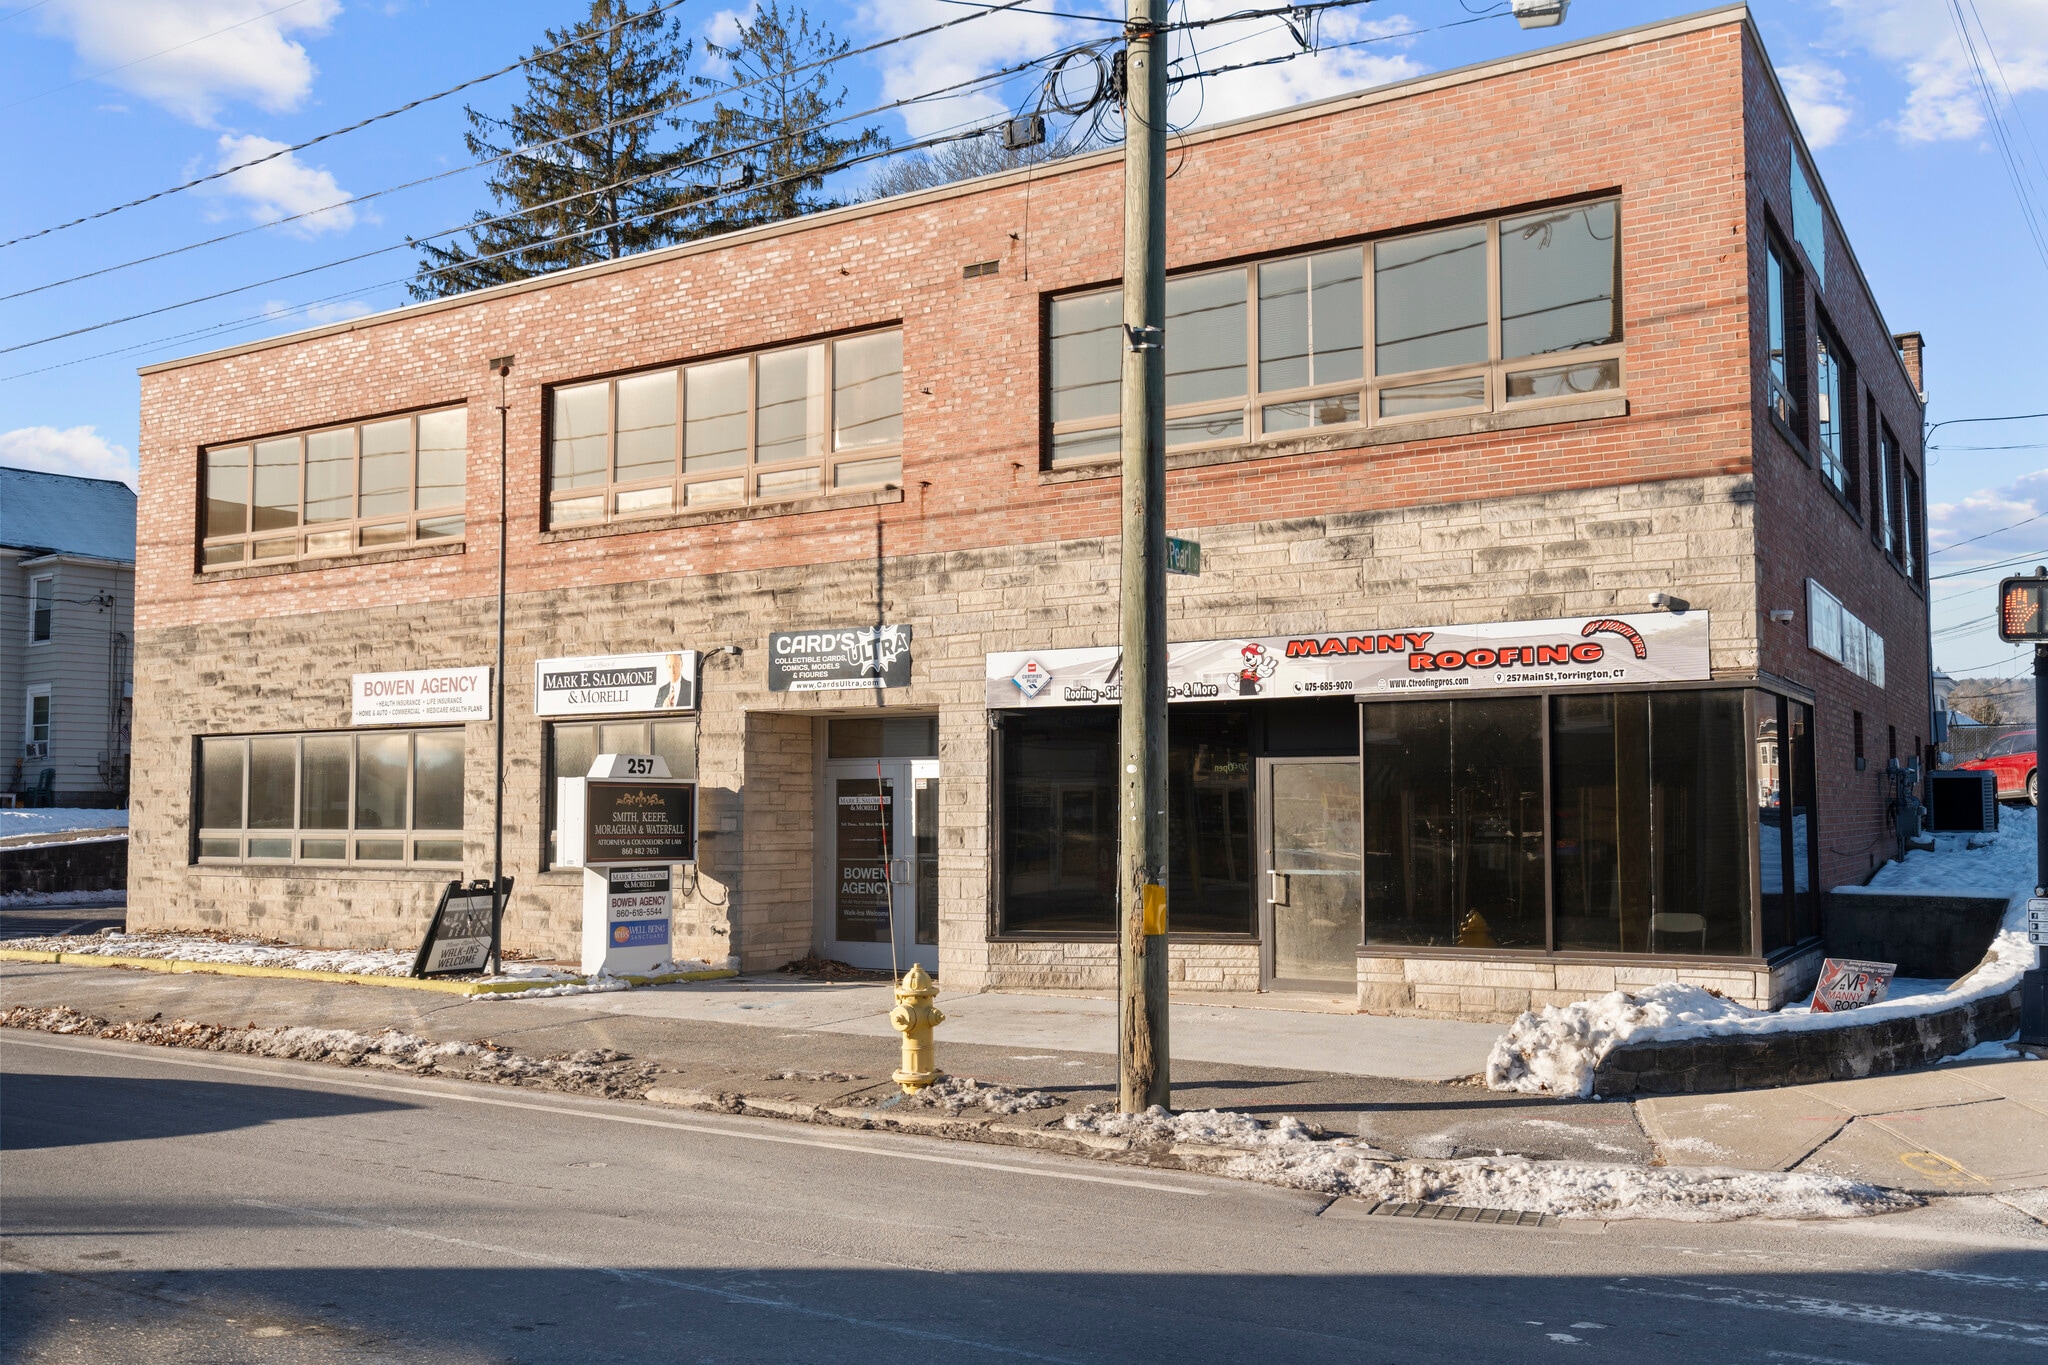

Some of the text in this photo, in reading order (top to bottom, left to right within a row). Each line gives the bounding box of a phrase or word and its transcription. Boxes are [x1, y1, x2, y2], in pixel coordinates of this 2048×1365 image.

[1169, 541, 1191, 569] Pearl
[776, 633, 855, 654] CARD'S
[1286, 632, 1434, 657] MANNY
[1582, 619, 1647, 658] OF NORTH WEST
[847, 633, 908, 666] ULTRA
[774, 655, 847, 664] COLLECTIBLE CARDS,
[1409, 643, 1604, 670] ROOFING
[545, 670, 654, 689] MARK E. SALOMONE
[1507, 674, 1521, 682] 257
[1522, 672, 1544, 681] Main
[1557, 670, 1612, 681] Torrington,
[1613, 669, 1625, 677] CT
[364, 675, 478, 697] BOWEN AGENCY
[796, 680, 879, 689] www.CardsUltra.com
[1304, 680, 1353, 691] 475-685-9070
[568, 689, 629, 704] & MORELLI
[1064, 686, 1098, 702] Roofing
[1183, 686, 1193, 697] &
[1193, 682, 1219, 696] More
[450, 705, 467, 713] HEALTH
[628, 758, 653, 774] 257
[612, 812, 668, 823] SMITH, KEEFE,
[595, 824, 685, 834] MORAGHAN & WATERFALL
[621, 847, 633, 855] 860
[844, 867, 888, 880] BOWEN
[630, 880, 655, 888] MORELLI
[841, 882, 889, 894] AGENCY
[612, 896, 666, 907] BOWEN AGENCY
[616, 907, 662, 917] 860-618-5544
[866, 909, 889, 917] Welcome
[629, 925, 666, 934] WELL BEING
[441, 944, 480, 958] WALK-INS
[438, 955, 477, 968] WELCOME
[1828, 991, 1862, 1001] MANNY
